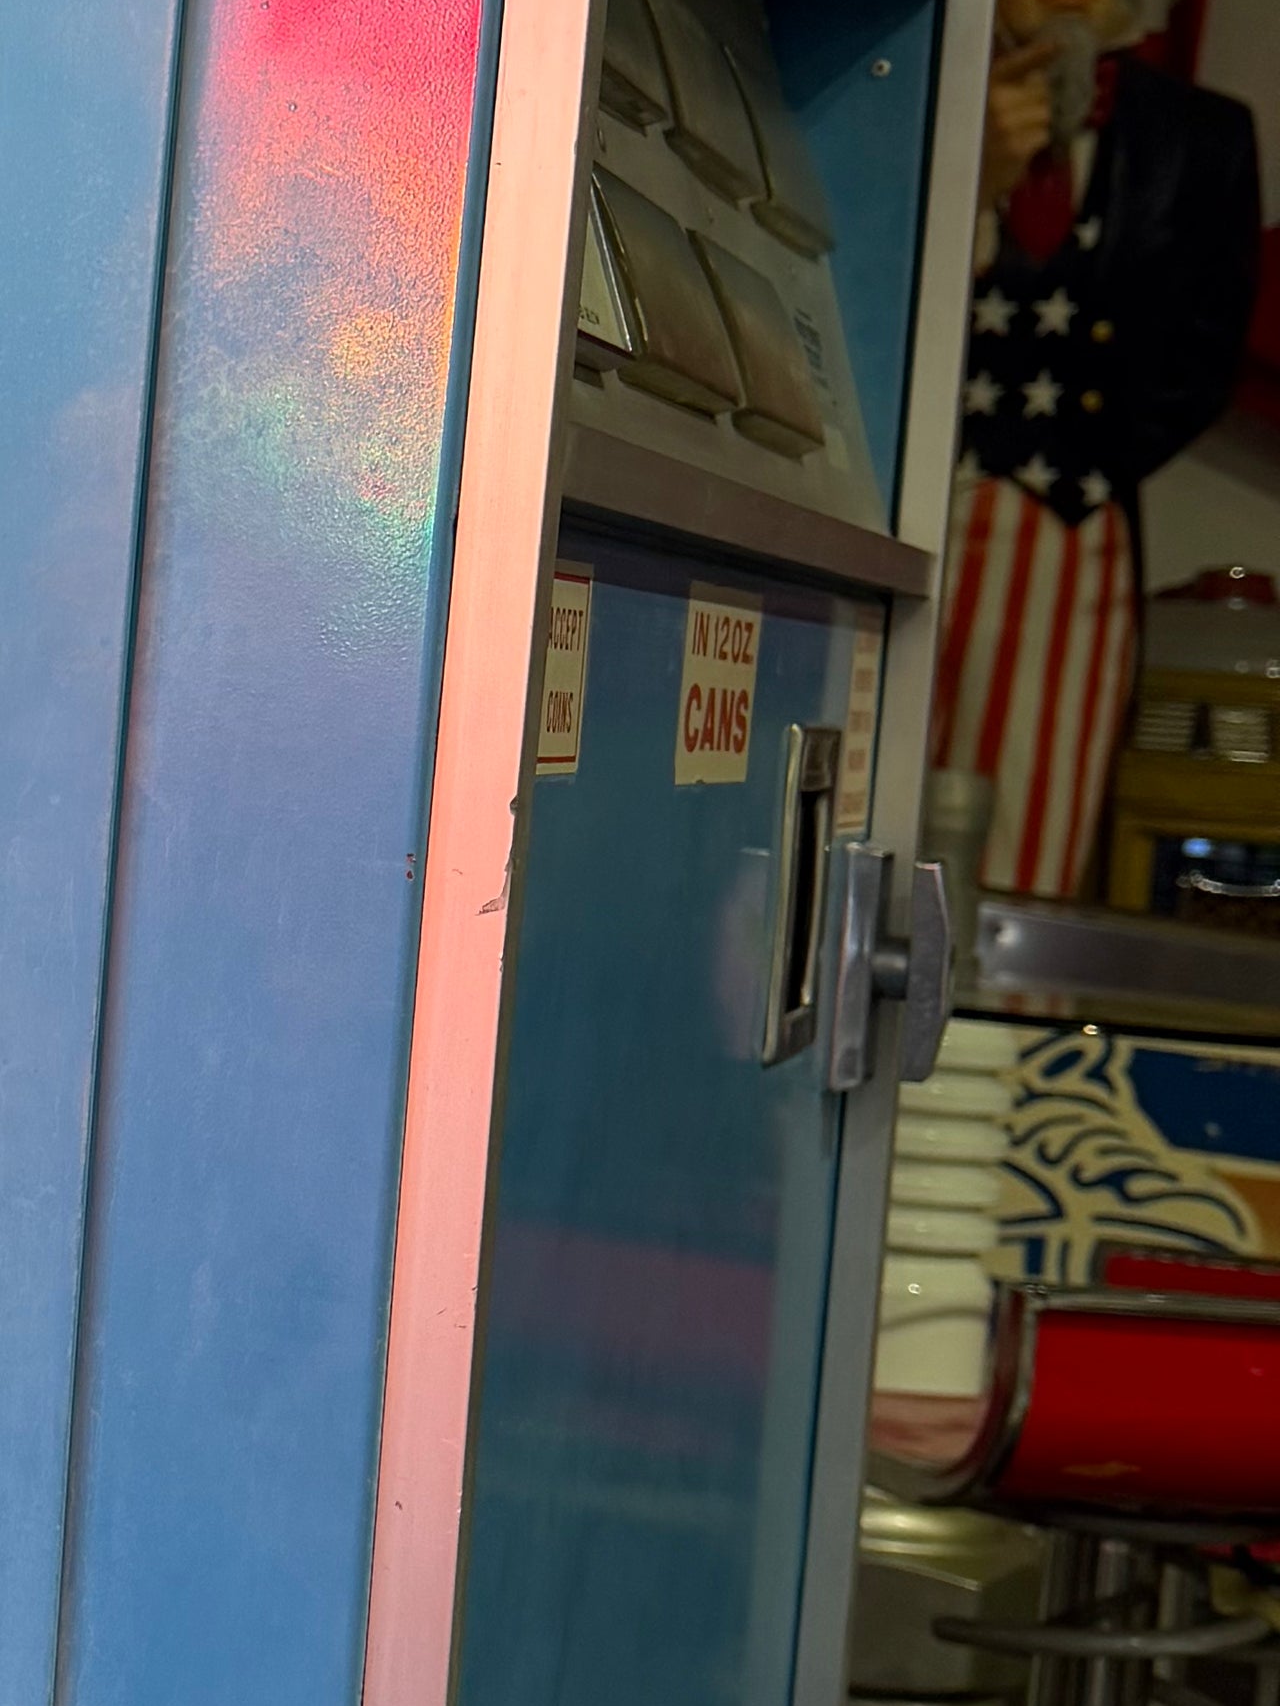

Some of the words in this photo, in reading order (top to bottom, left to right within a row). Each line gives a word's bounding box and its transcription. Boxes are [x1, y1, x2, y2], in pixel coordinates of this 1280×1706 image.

[692, 611, 711, 657] IN
[546, 690, 574, 734] COINS
[683, 683, 749, 755] CANS
